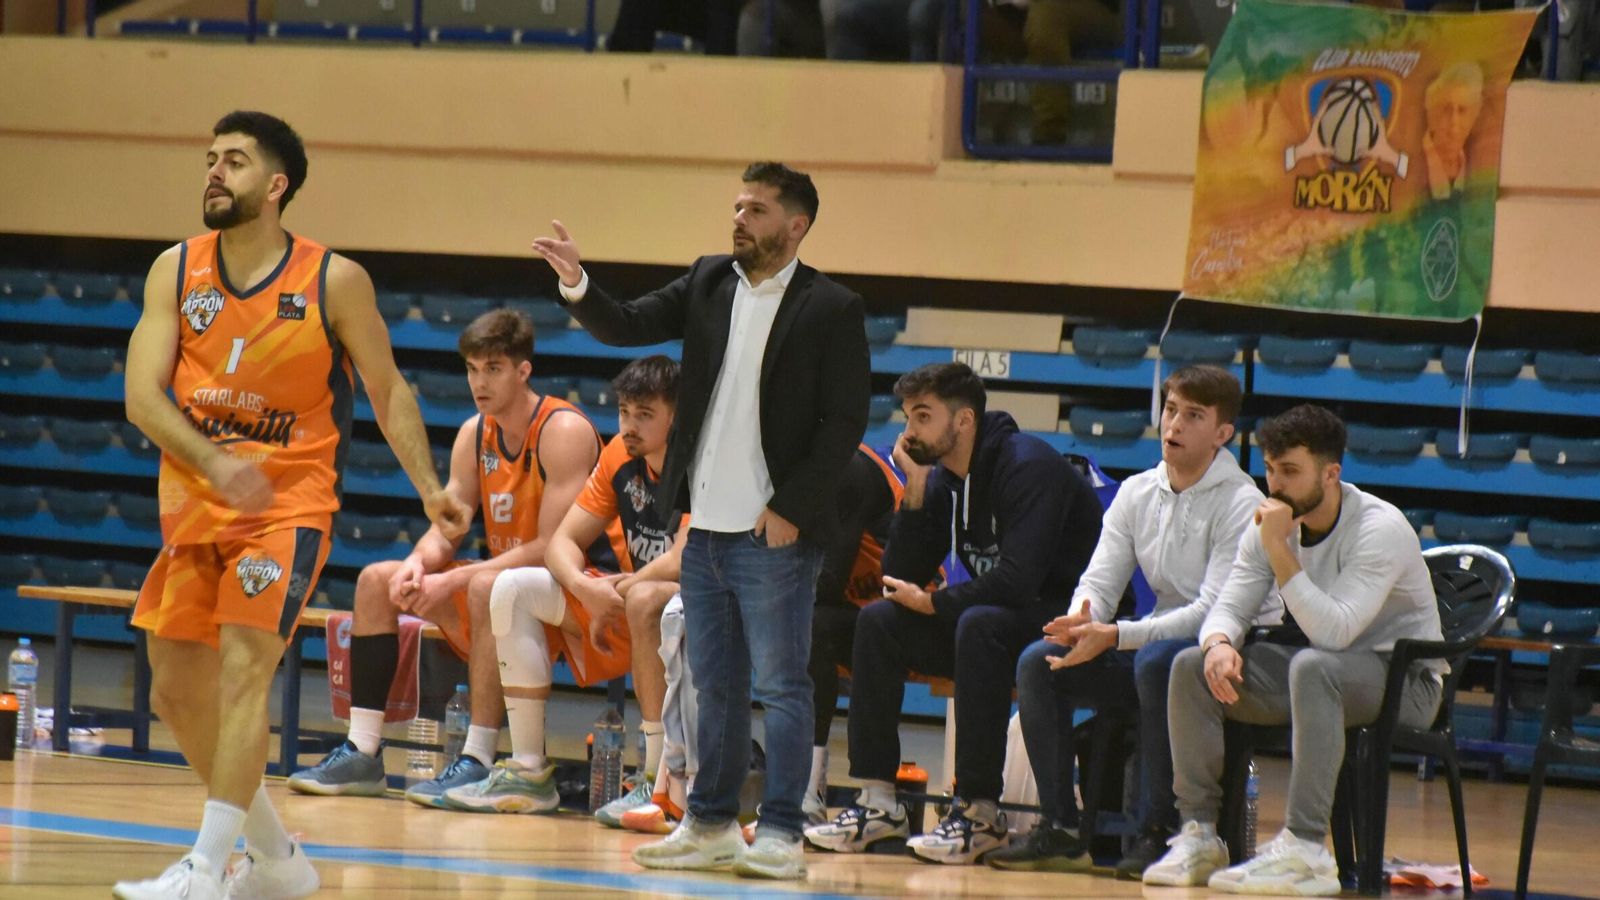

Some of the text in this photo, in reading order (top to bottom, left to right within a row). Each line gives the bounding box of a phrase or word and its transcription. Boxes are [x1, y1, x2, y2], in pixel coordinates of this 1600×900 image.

[225, 337, 245, 375] 1
[193, 387, 266, 413] STARLABS
[489, 492, 514, 523] 12
